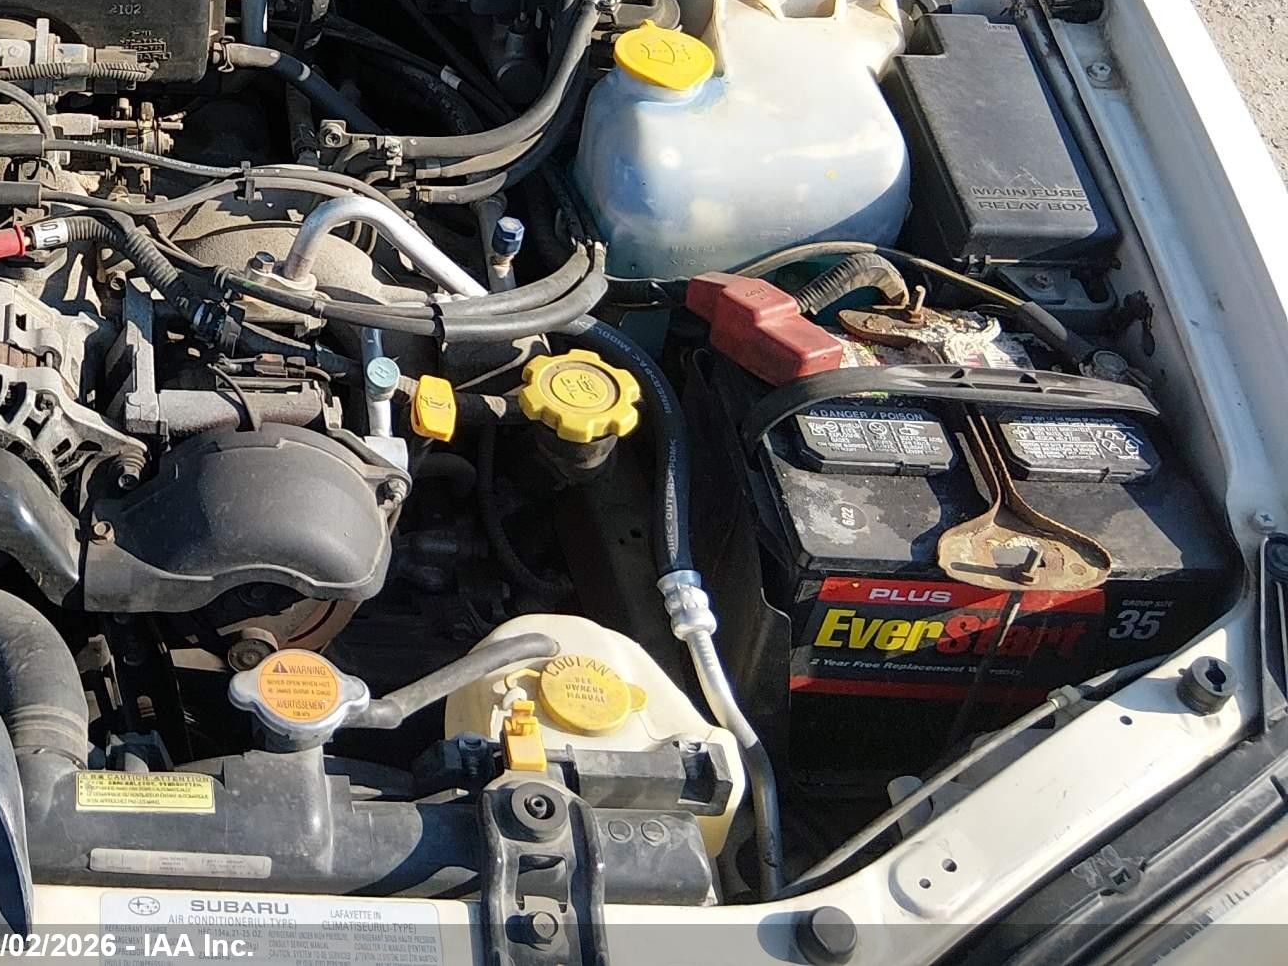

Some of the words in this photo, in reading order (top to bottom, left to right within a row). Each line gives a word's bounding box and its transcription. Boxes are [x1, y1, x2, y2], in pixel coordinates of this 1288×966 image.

[972, 185, 1028, 196] MAIN
[1030, 187, 1087, 199] FUSE
[978, 200, 1041, 211] RELAY
[1046, 202, 1092, 212] BOX
[820, 409, 868, 420] DANGER
[879, 411, 924, 422] POISON
[869, 587, 953, 603] PLUS
[1108, 609, 1166, 640] 35
[288, 664, 327, 676] WARNING
[809, 657, 821, 666] 2
[823, 658, 851, 668] Year
[852, 660, 881, 669] Free
[882, 661, 965, 674] Replacement
[190, 899, 290, 915] SUBARU
[168, 913, 184, 925] AIR
[330, 909, 372, 920] LAFAYETTE
[373, 911, 382, 921] IN
